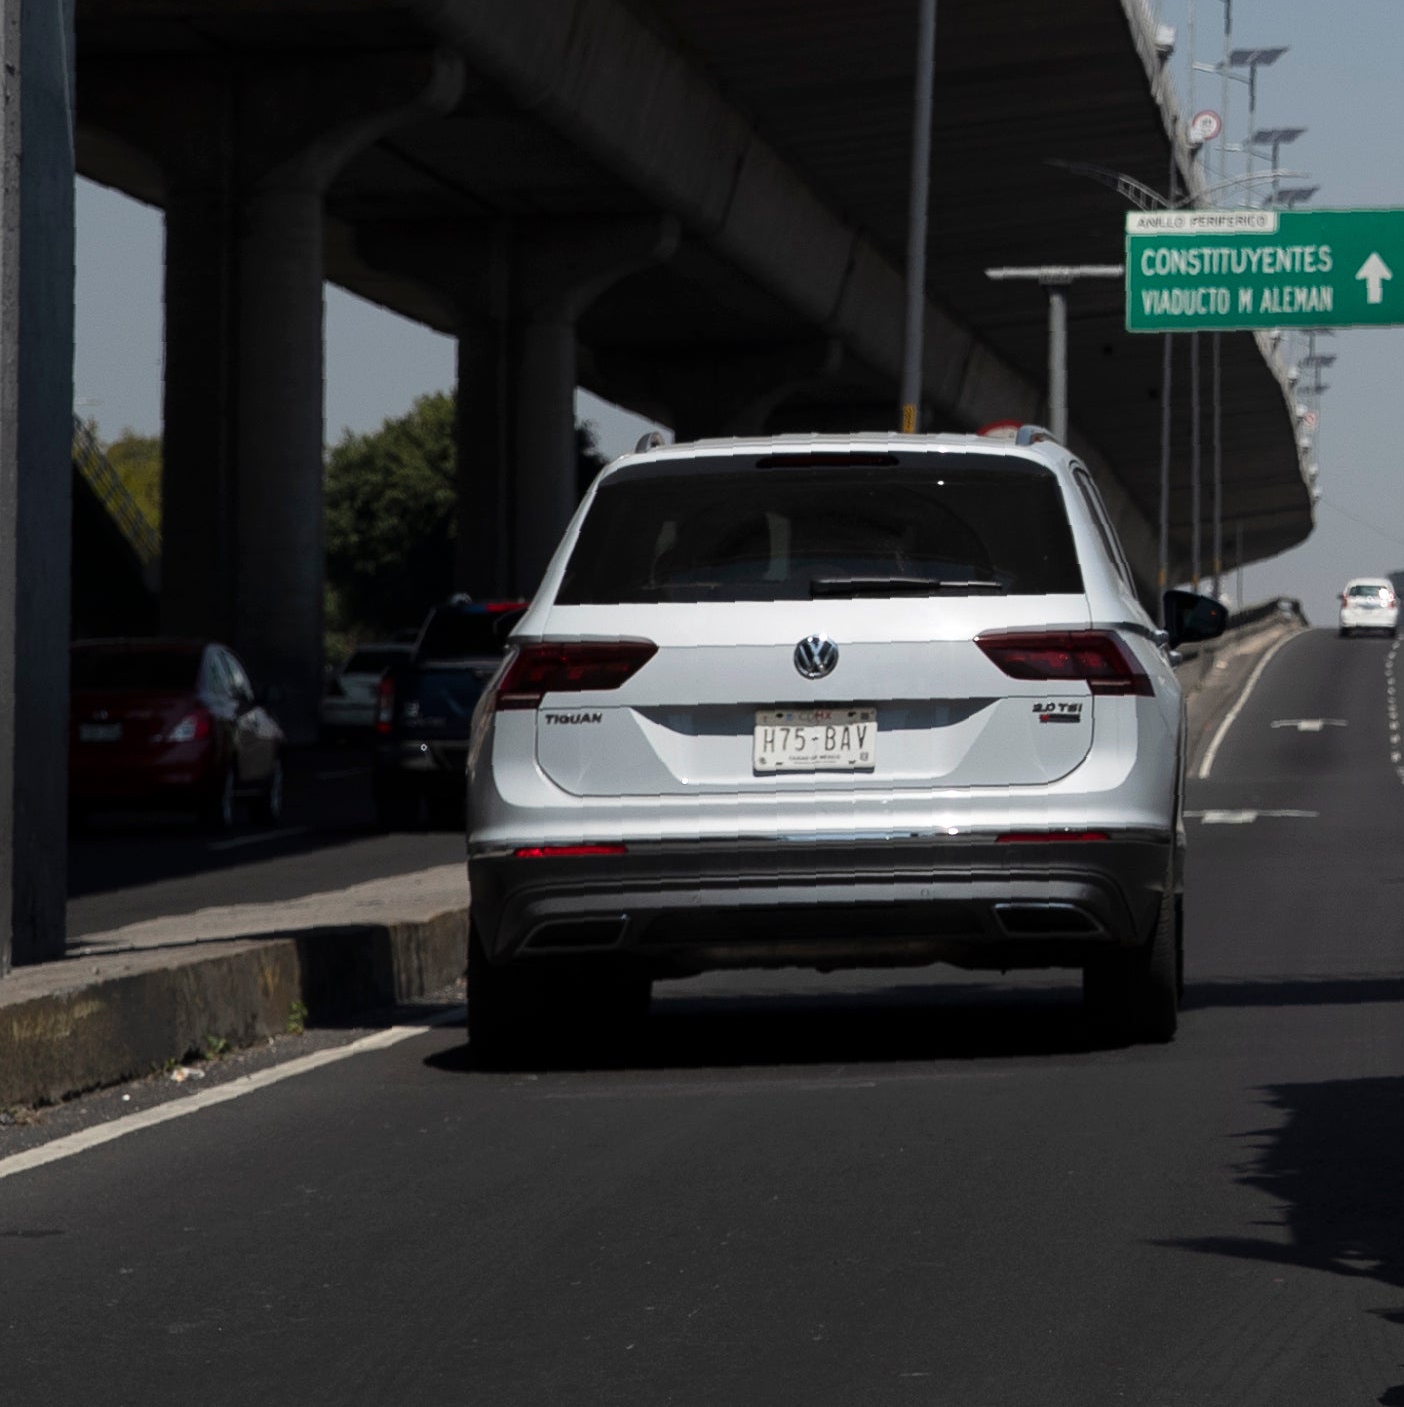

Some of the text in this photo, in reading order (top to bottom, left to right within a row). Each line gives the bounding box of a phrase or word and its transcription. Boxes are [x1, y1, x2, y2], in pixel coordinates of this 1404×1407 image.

[1137, 214, 1268, 229] ANILLO PERIFERICO
[1141, 245, 1334, 276] CONSTITUYENTES
[1141, 287, 1231, 315] VIADUCTO
[1260, 285, 1334, 313] ALEMAN
[545, 713, 602, 725] TIGUAN
